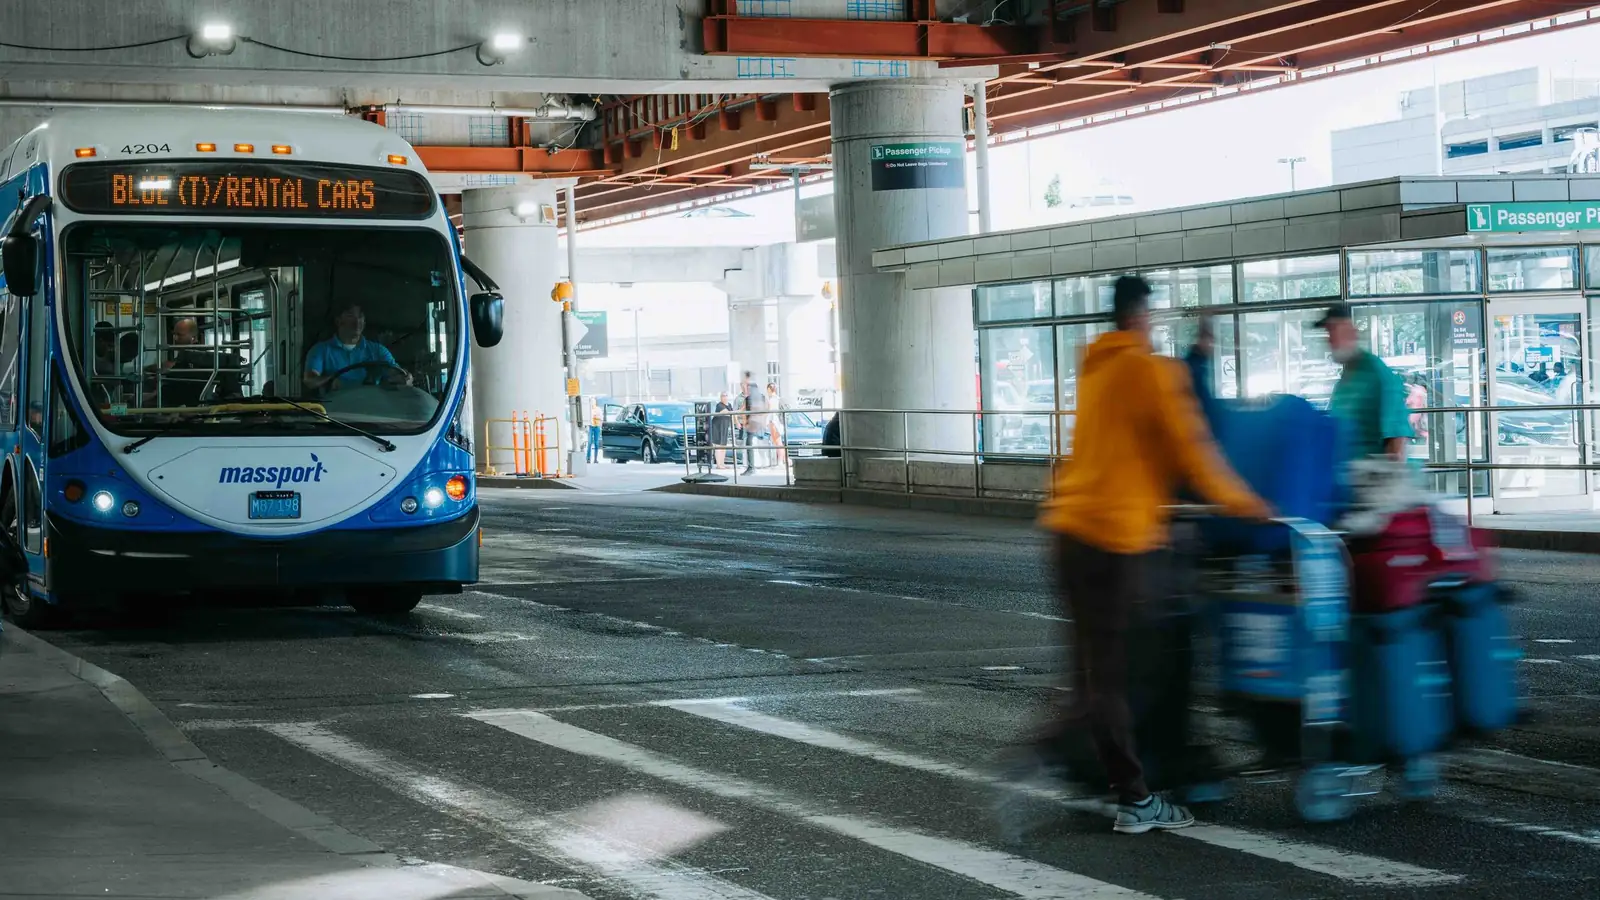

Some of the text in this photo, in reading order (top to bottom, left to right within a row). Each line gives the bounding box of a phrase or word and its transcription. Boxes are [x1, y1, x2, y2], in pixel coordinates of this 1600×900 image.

[121, 143, 171, 154] 4204
[885, 143, 952, 156] Passenger Pickup
[112, 174, 375, 209] BLUE (T)/RENTAL CARS
[1497, 208, 1582, 228] Passenger
[219, 460, 324, 489] massport
